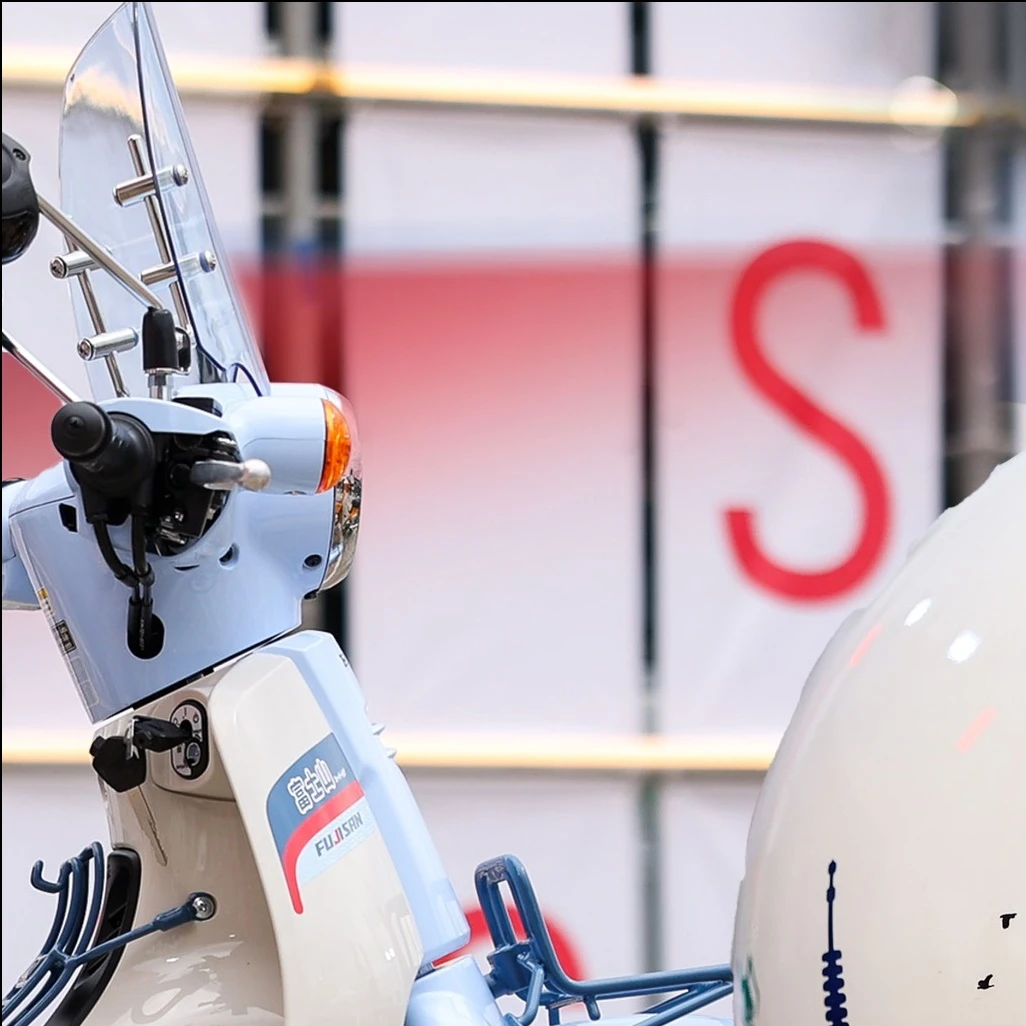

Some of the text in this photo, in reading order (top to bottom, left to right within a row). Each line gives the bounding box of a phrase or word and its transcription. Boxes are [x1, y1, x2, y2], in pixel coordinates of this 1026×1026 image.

[726, 238, 891, 603] S
[287, 757, 337, 815] 富士山
[314, 812, 364, 857] FUJISAN
